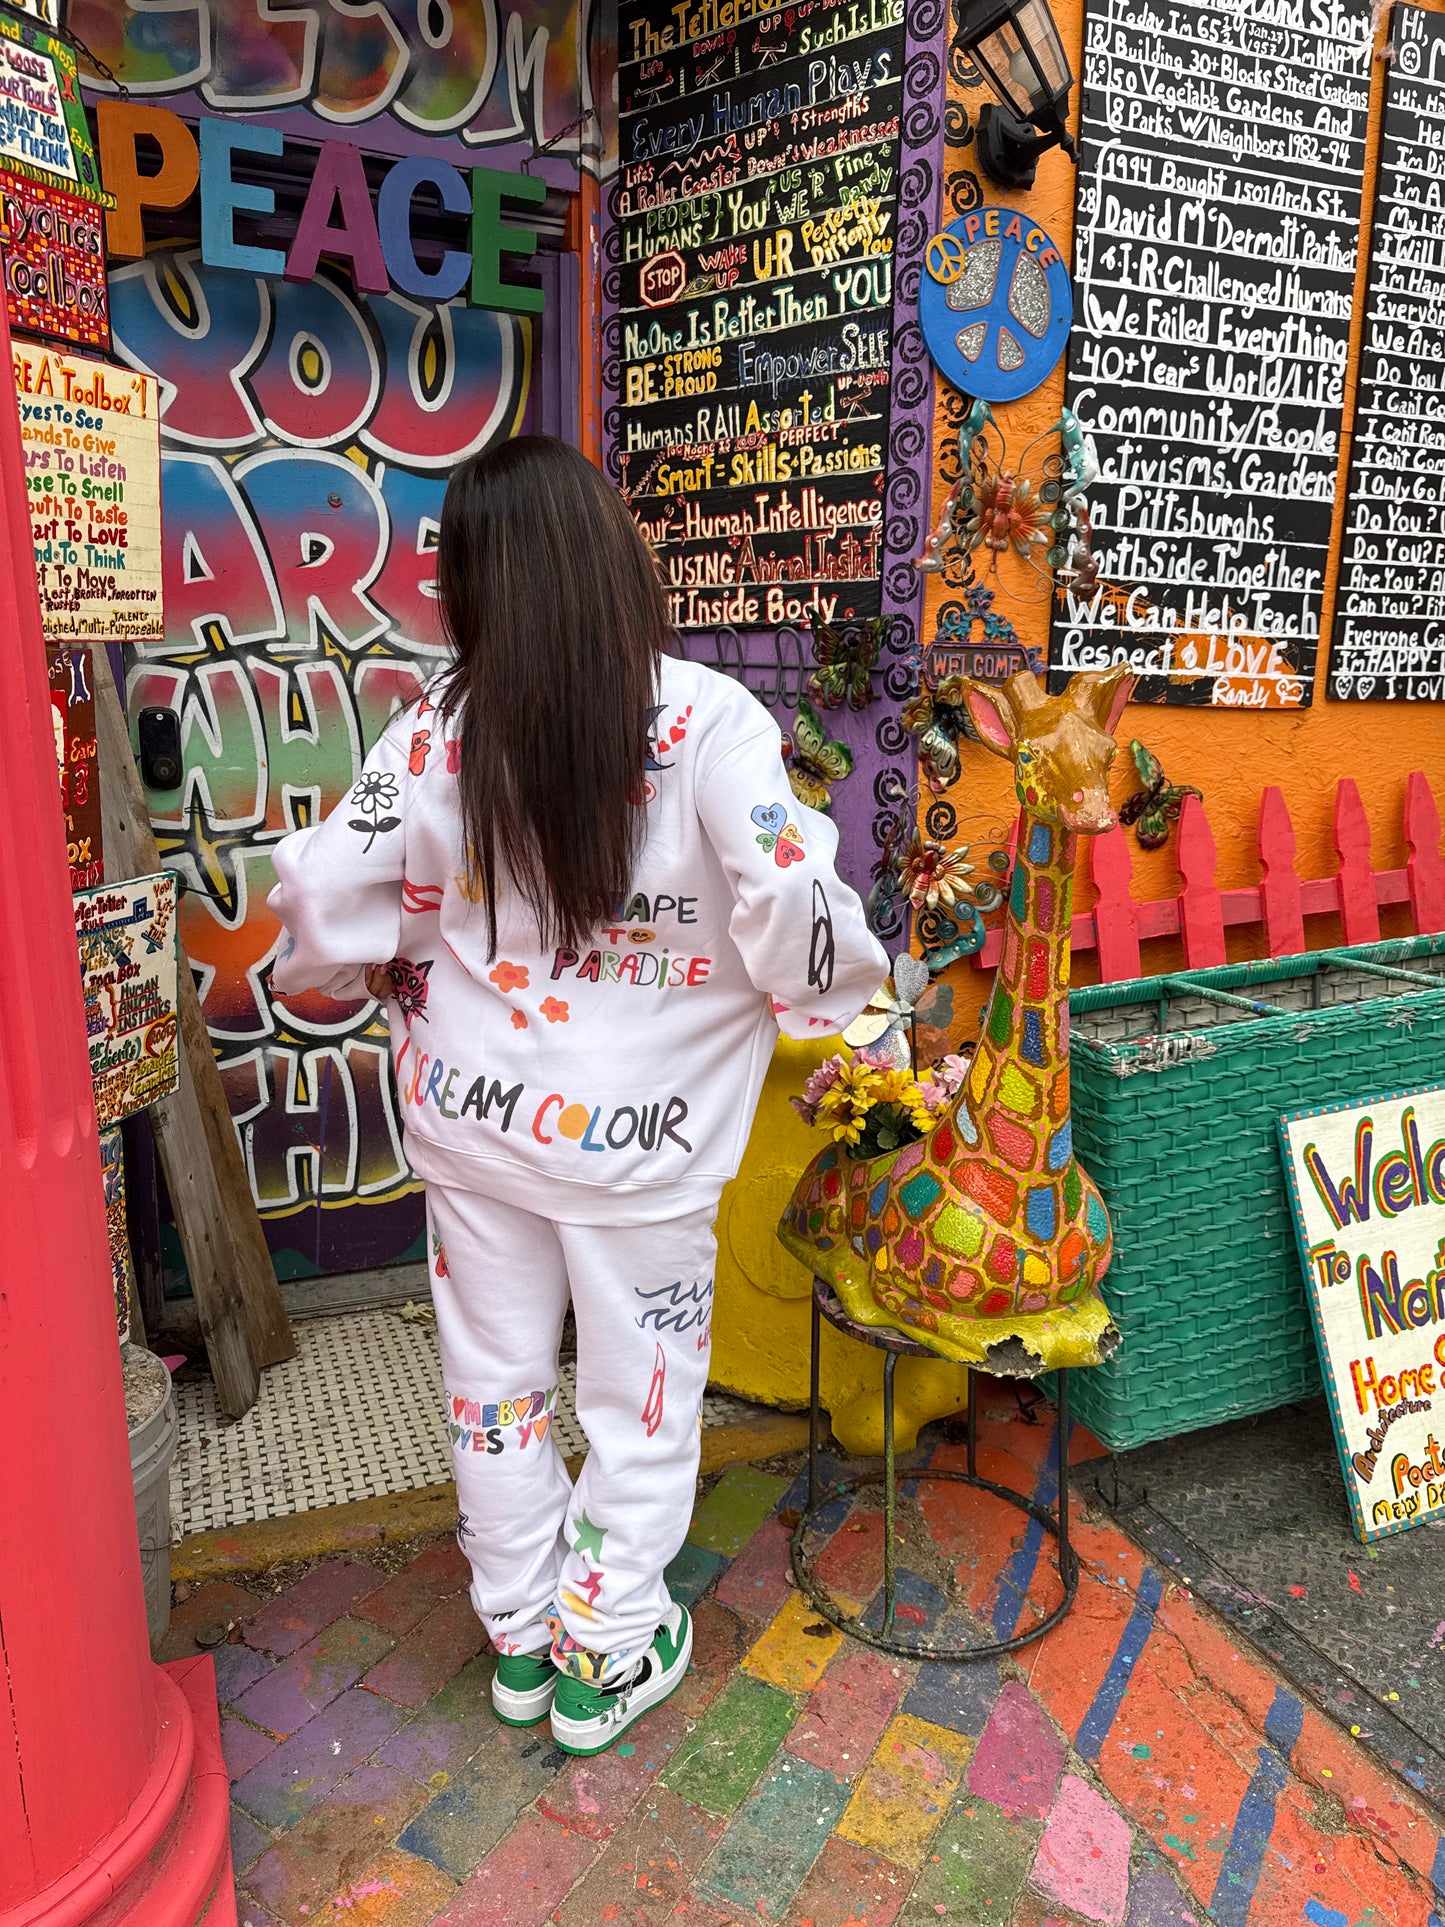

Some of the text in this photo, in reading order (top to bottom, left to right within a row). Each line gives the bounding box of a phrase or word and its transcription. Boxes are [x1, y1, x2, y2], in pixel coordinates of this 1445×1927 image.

[629, 18, 674, 60] The
[759, 13, 783, 33] UP
[799, 4, 868, 55] Such Is
[1115, 0, 1165, 40] Today
[1168, 9, 1193, 39] I'm
[1401, 7, 1429, 47] Hi,
[47, 38, 79, 80] Nose
[1115, 30, 1184, 79] Building
[1221, 53, 1272, 84] Blocks
[1273, 68, 1318, 98] Street
[1319, 75, 1369, 109] Gardens
[18, 76, 58, 112] TOOLS
[632, 47, 895, 163] Every Human Plays
[801, 94, 871, 130] Strengths
[1139, 62, 1221, 112] Vegetable
[1226, 87, 1304, 125] Gardens
[1313, 104, 1354, 139] And
[40, 114, 67, 143] YOU
[70, 127, 94, 159] Ears
[1129, 98, 1175, 138] Parks
[1288, 133, 1350, 167] 1982-94
[18, 129, 71, 171] THINK
[619, 115, 900, 215] A Roller Coaster Weaknesses
[1396, 145, 1422, 171] I'm
[646, 150, 875, 235] PEOPLE US Fine
[1105, 151, 1347, 219] 1994 Bought 1501 Arch St.
[1393, 174, 1421, 204] I'm
[97, 99, 548, 314] PEACE
[624, 165, 893, 262] HUMANS WE Dandy
[1104, 194, 1172, 240] David
[1388, 205, 1419, 241] My
[646, 195, 882, 291] STOP WAKE Perfectly
[862, 237, 893, 257] You
[965, 209, 1060, 270] PEACE
[1394, 235, 1437, 266] Will
[714, 268, 741, 290] UP
[1285, 272, 1354, 317] Humans
[1378, 263, 1405, 292] I'm
[712, 295, 776, 342] Better
[772, 284, 828, 327] Then
[832, 258, 893, 316] YOU
[1088, 293, 1139, 336] We
[1146, 298, 1211, 344] Failed
[1217, 305, 1348, 365] Everything
[1371, 322, 1443, 360] We Are
[664, 345, 722, 378] STRONG
[664, 340, 839, 401] PROUD Empower
[1376, 357, 1438, 390] Do You
[54, 403, 104, 432] To See
[627, 418, 693, 452] Humans
[744, 382, 834, 436] Assorted
[63, 427, 117, 456] To Give
[54, 447, 127, 482] To Listen
[657, 455, 715, 497] Smart
[729, 442, 793, 487] Skills
[800, 437, 882, 478] Passions
[1241, 453, 1338, 498] Gardens
[57, 472, 125, 503] To Smell
[1371, 474, 1437, 504] Only Go
[64, 497, 129, 526] To Taste
[685, 486, 883, 540] Human Intelligence
[1117, 485, 1276, 559] Pittsburghs
[1356, 503, 1383, 531] Do
[64, 519, 83, 543] To
[87, 523, 129, 549] LOVE
[1353, 535, 1379, 561] Do
[58, 541, 79, 565] To
[84, 544, 126, 571] Think
[669, 535, 812, 585] USING Animal
[1213, 542, 1321, 605] Together
[54, 564, 117, 590] To Move
[111, 588, 158, 602] FORGOTTEN
[1350, 564, 1381, 591] Are
[46, 600, 81, 613] RUSTED
[111, 609, 150, 622] TALENTS
[688, 586, 760, 625] Inside
[1126, 586, 1177, 629] Can
[1185, 588, 1248, 647] Help
[1251, 592, 1319, 635] Teach
[1346, 592, 1378, 616] Can
[1343, 619, 1419, 648] Everyone
[932, 652, 1021, 679] WELCOME
[1061, 630, 1288, 676] Respect LOVE
[1338, 651, 1366, 673] I'm
[1211, 678, 1271, 708] Randy
[118, 990, 162, 1014] ANIMAL
[120, 974, 160, 1001] HUMAN
[532, 1093, 694, 1154] COLOUR
[1310, 1238, 1352, 1289] To
[1348, 1356, 1437, 1415] Home
[1351, 1397, 1433, 1485] Architecture
